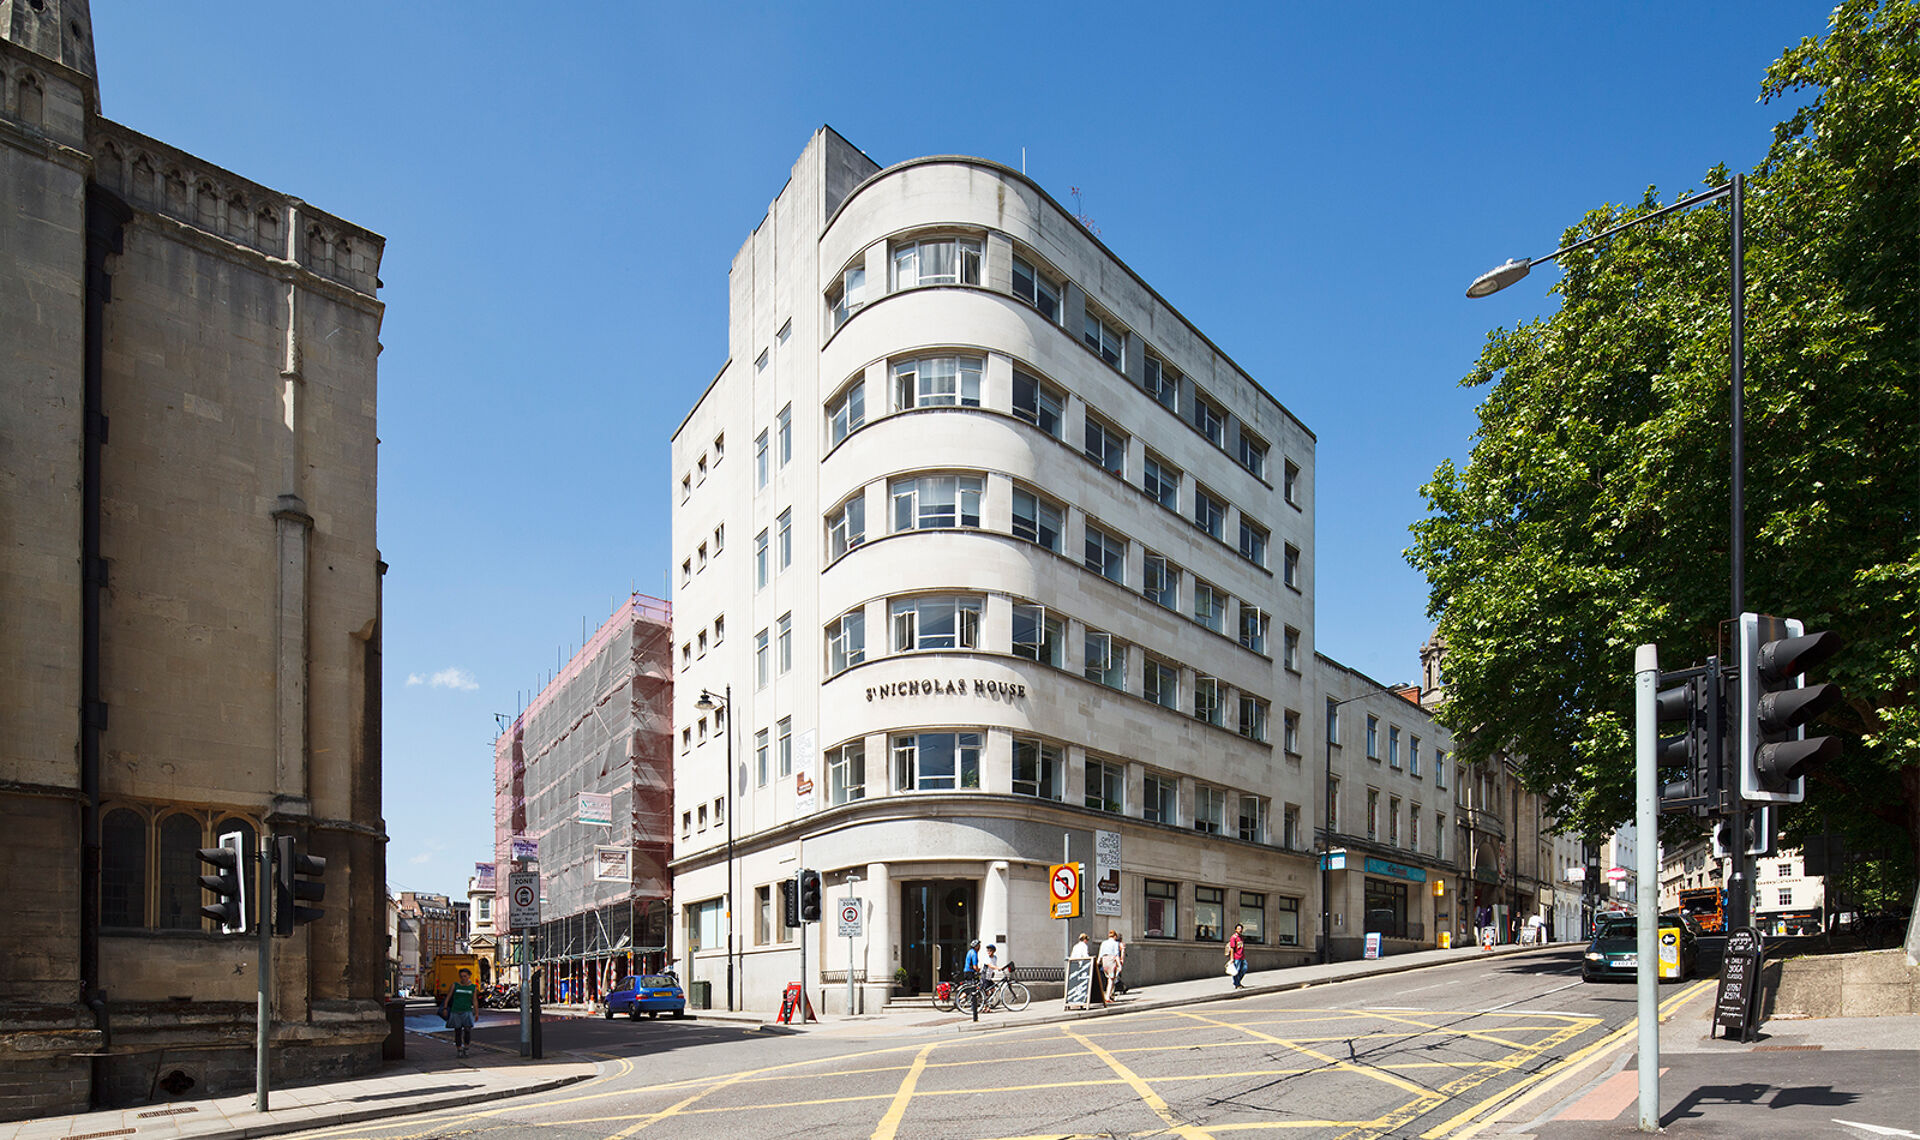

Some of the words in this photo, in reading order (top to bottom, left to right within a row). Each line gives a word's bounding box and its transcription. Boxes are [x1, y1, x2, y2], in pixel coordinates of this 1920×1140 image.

[879, 678, 967, 699] NICHOLAS
[974, 679, 1026, 699] HOUSE
[1728, 964, 1744, 973] YOGA
